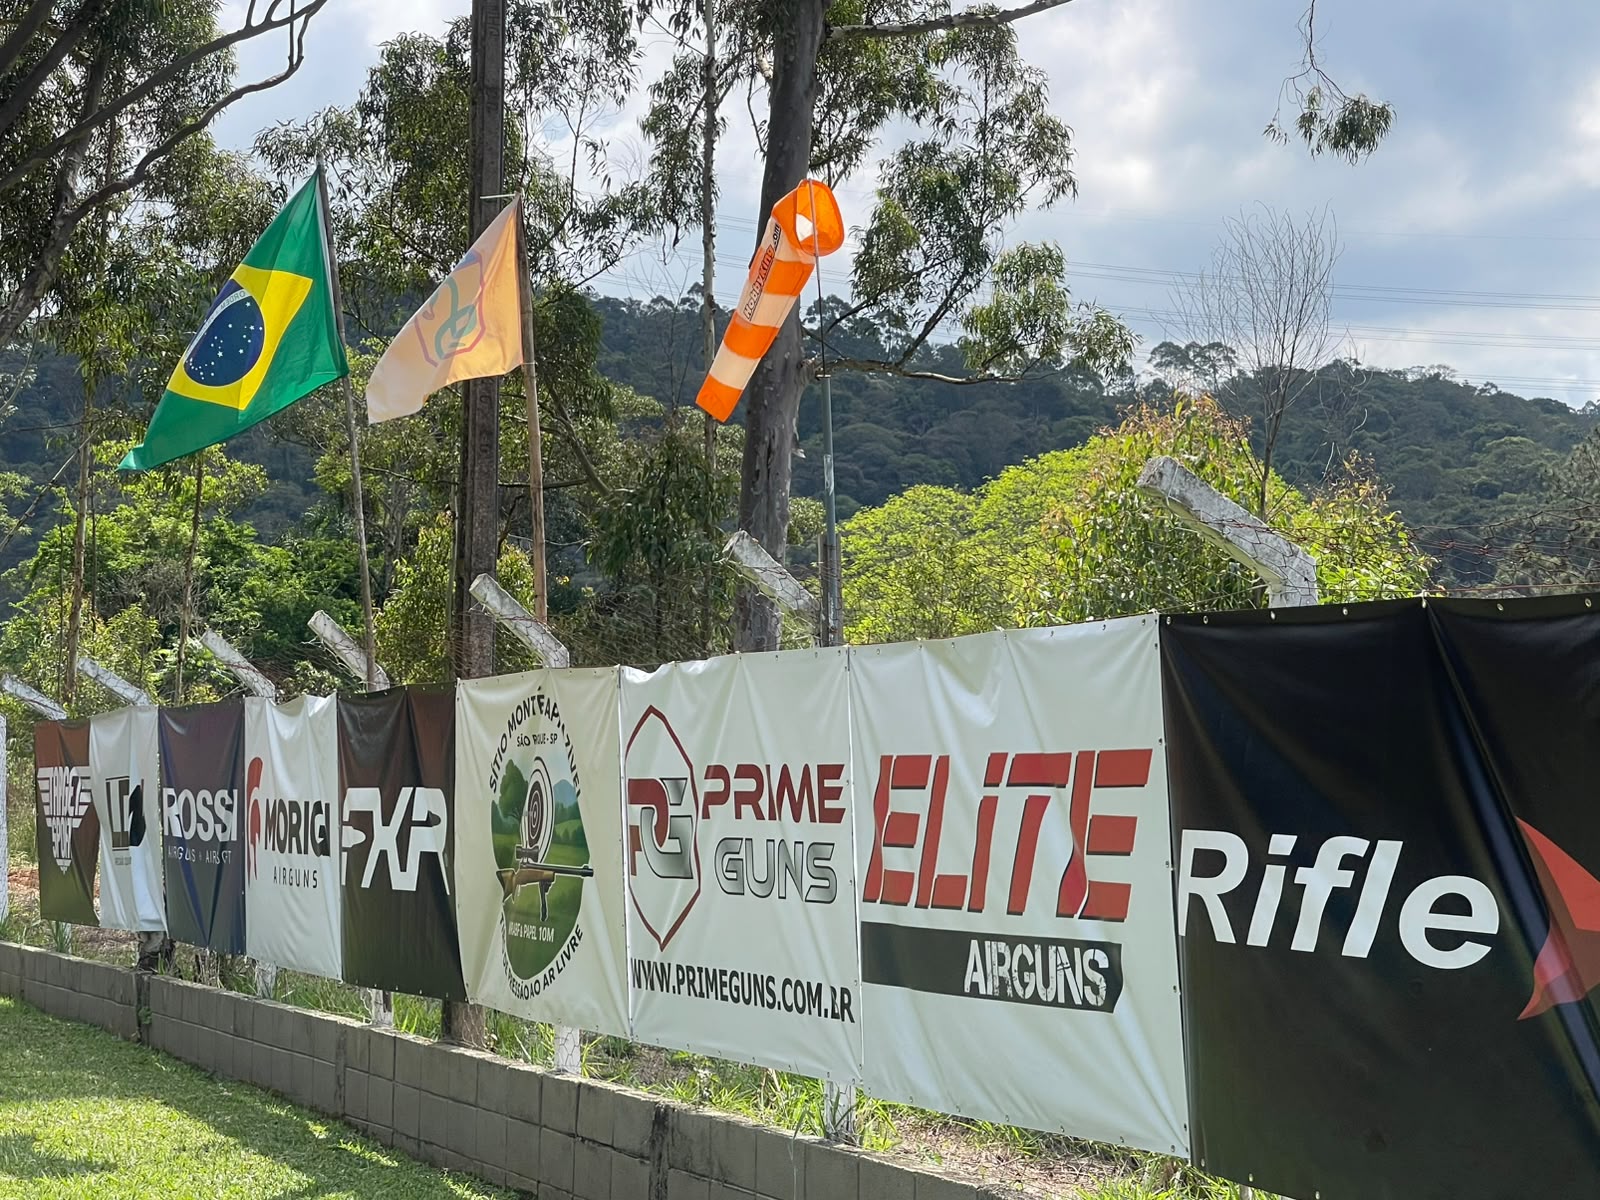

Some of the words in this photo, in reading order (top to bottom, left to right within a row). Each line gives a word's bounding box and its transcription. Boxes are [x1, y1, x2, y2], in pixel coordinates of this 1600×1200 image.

[162, 787, 238, 842] ROSSI
[701, 763, 845, 824] PRIME
[264, 798, 331, 857] MORIGI
[273, 865, 318, 889] AIRGUNS
[714, 836, 838, 904] GUNS
[1177, 828, 1500, 970] Rifle
[523, 923, 537, 941] PAPEL
[538, 926, 555, 943] 10M
[542, 967, 556, 991] AR
[555, 924, 584, 974] LIVRE
[963, 939, 1110, 1006] AIRGUNS
